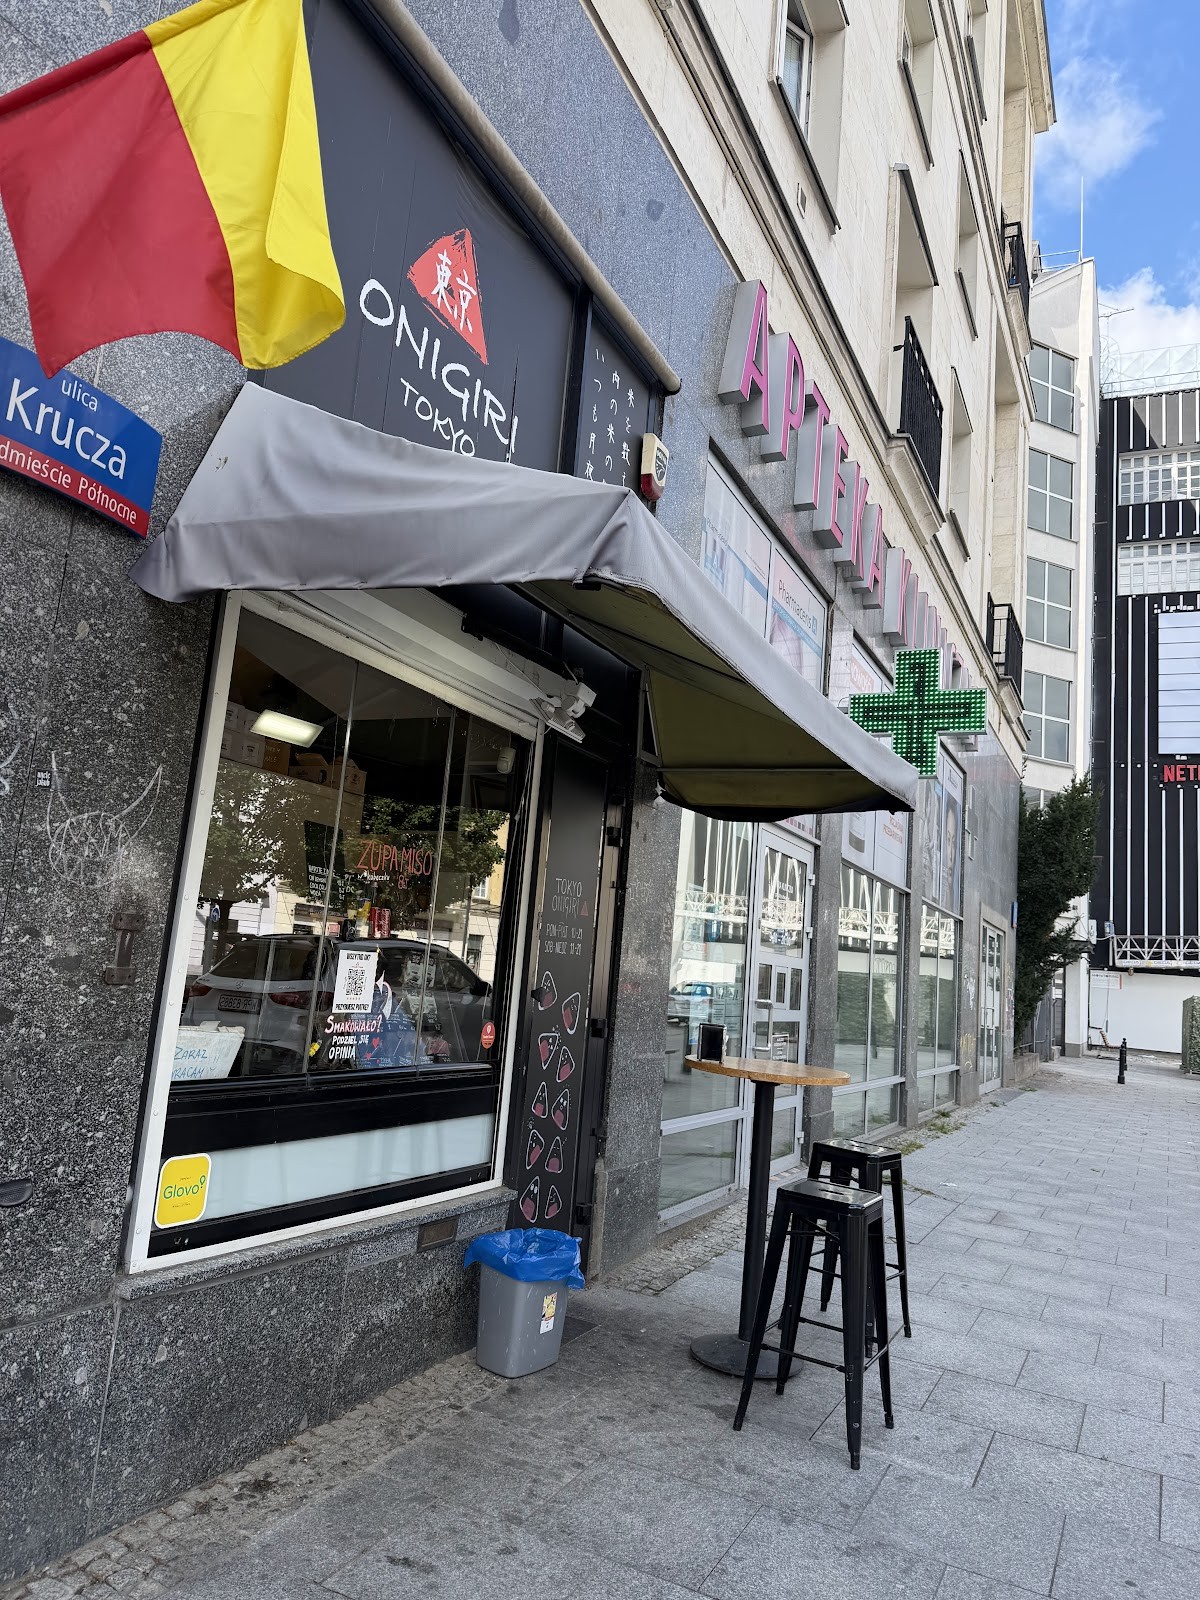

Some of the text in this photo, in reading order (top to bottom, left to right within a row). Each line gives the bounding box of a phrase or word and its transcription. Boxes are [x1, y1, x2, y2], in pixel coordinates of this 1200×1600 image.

[431, 249, 477, 333] 東京
[360, 279, 519, 454] ONIGIRI
[61, 379, 98, 412] ulica
[6, 377, 127, 480] Krucza
[401, 378, 475, 457] TOKYO
[730, 280, 883, 610] APTEKA
[78, 476, 137, 525] Północne
[778, 579, 812, 629] Pharmaceris
[356, 839, 433, 876] ZUPA MISO
[551, 895, 580, 919] ONIGIRI
[555, 877, 583, 898] TOKYO
[174, 1046, 208, 1061] ZARAZ
[332, 1035, 369, 1045] PODZIEL SIĘ
[163, 1184, 200, 1199] Glovo
